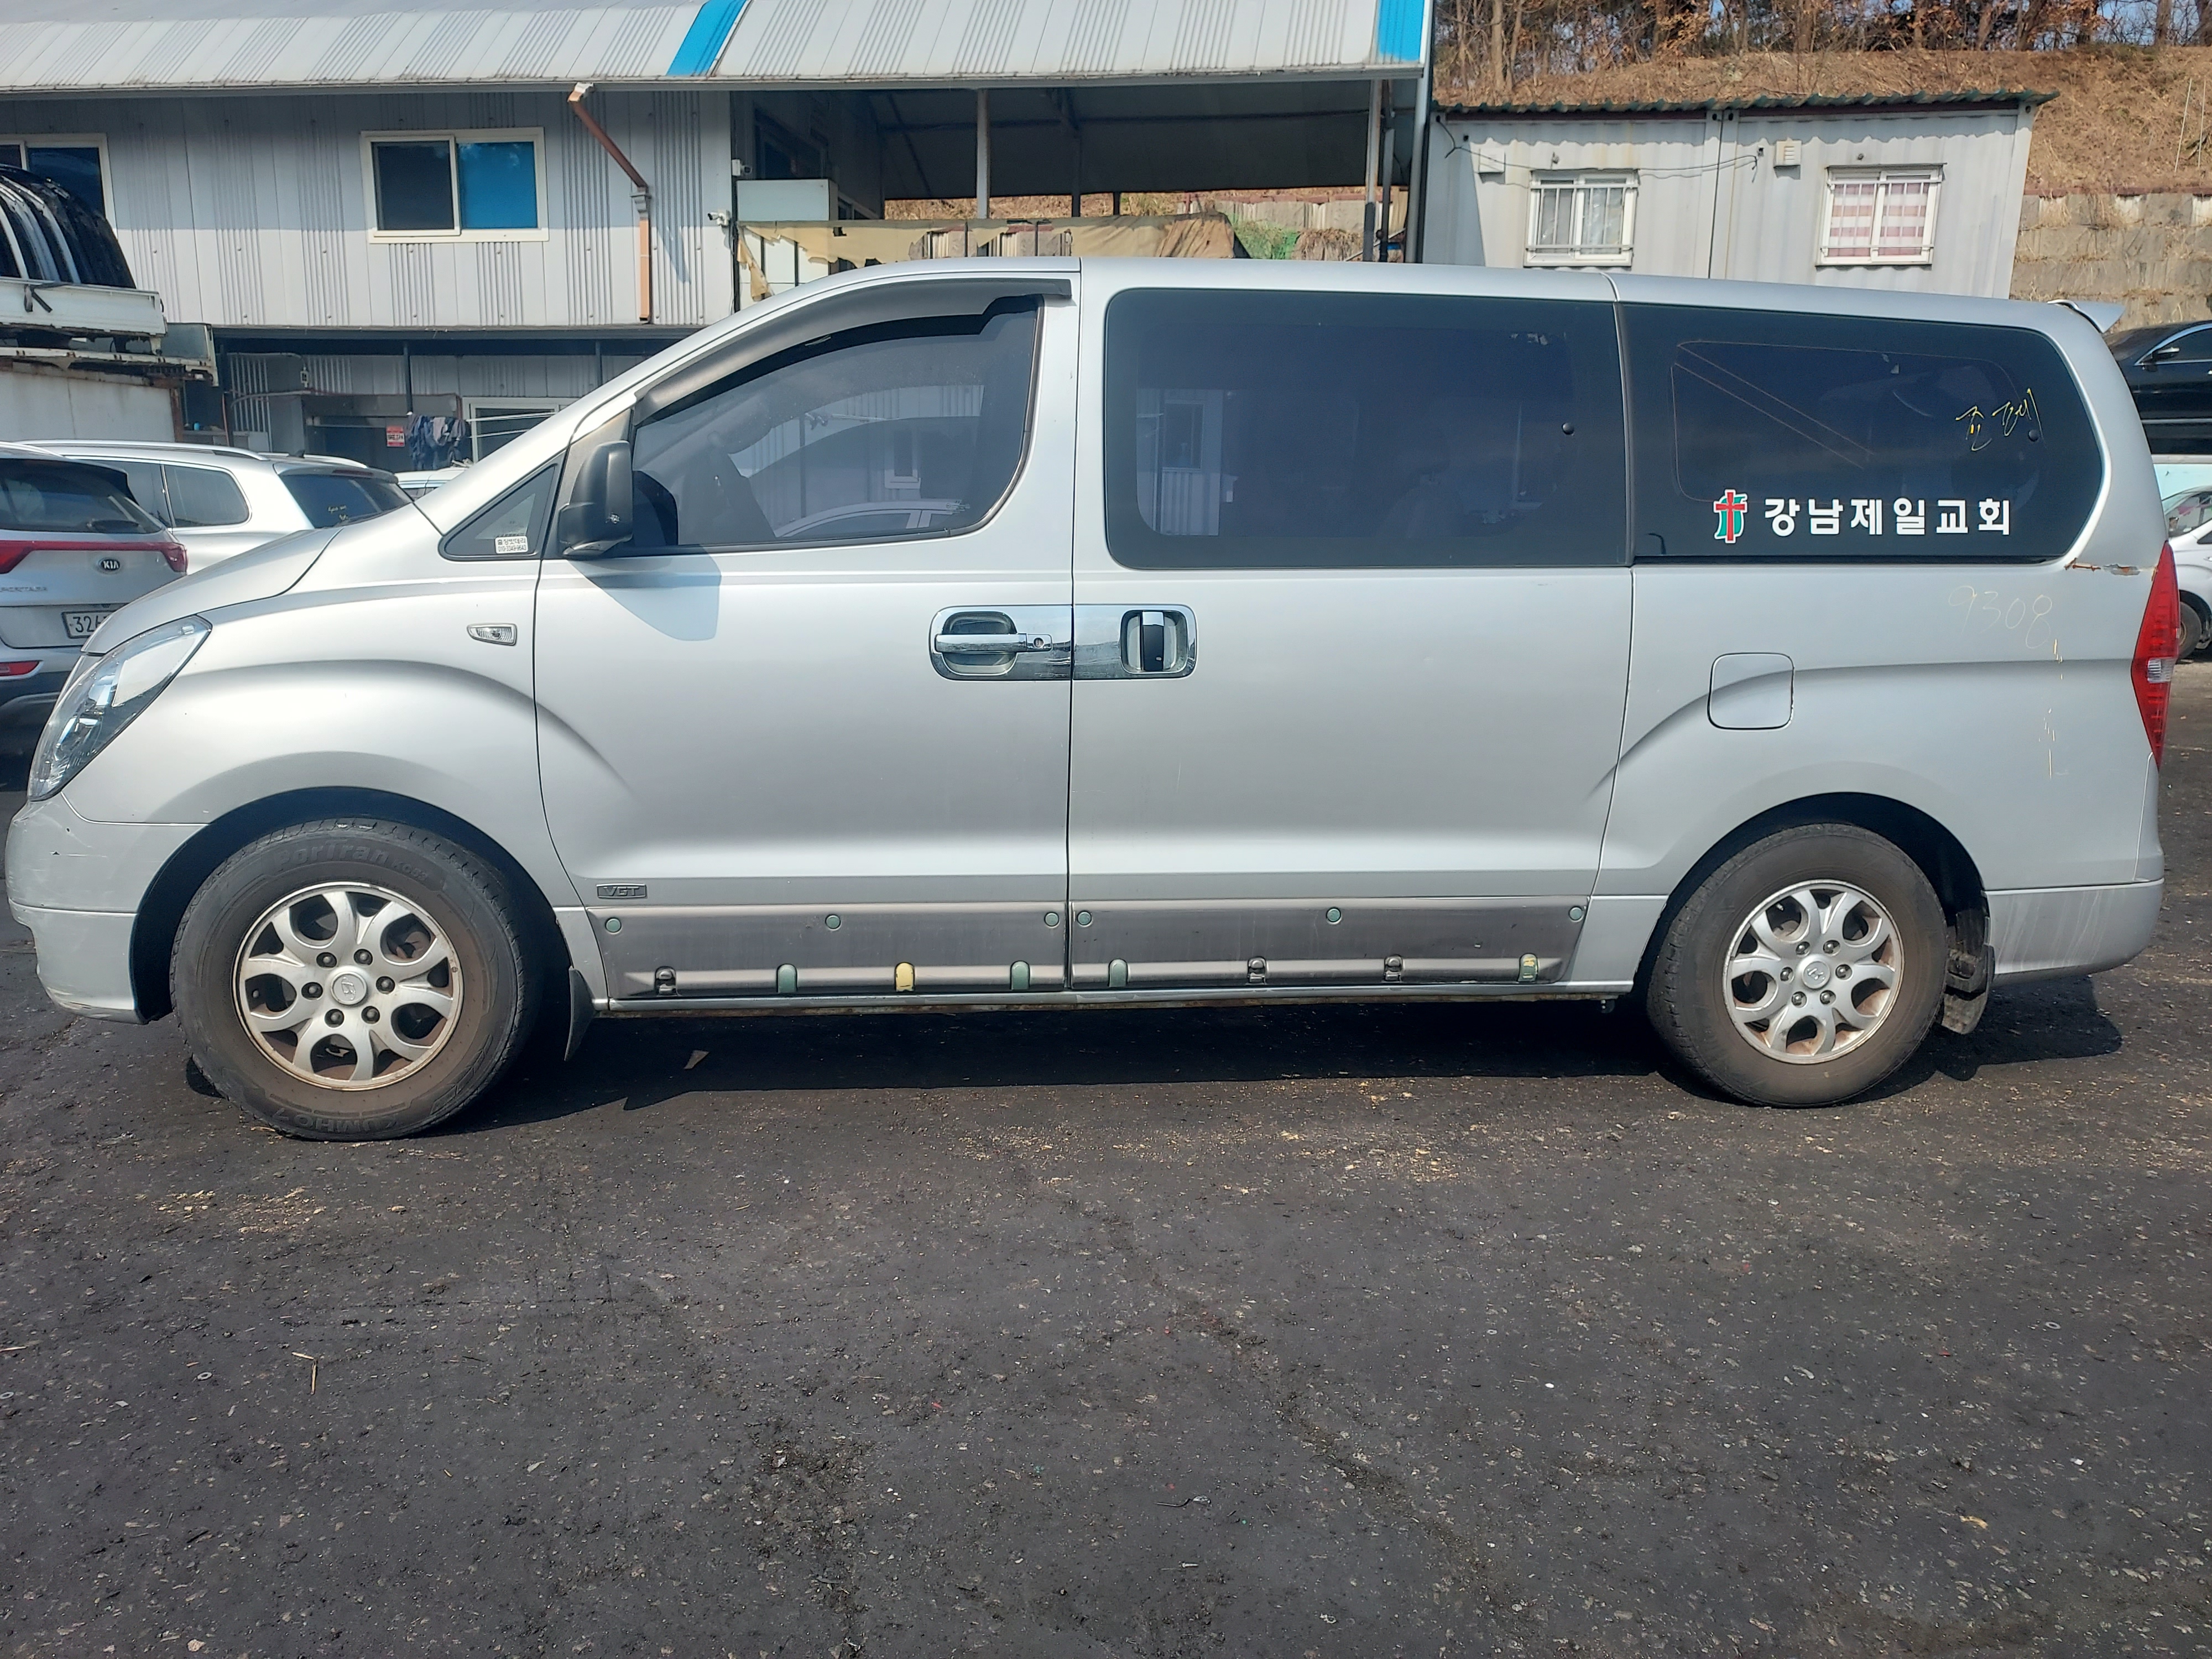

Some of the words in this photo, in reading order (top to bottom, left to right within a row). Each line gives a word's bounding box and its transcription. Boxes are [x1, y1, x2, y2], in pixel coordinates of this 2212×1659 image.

[1765, 498, 2010, 536] 강남제일교회
[103, 560, 118, 569] KIA
[1948, 585, 2053, 649] 9308
[603, 886, 639, 896] VGT
